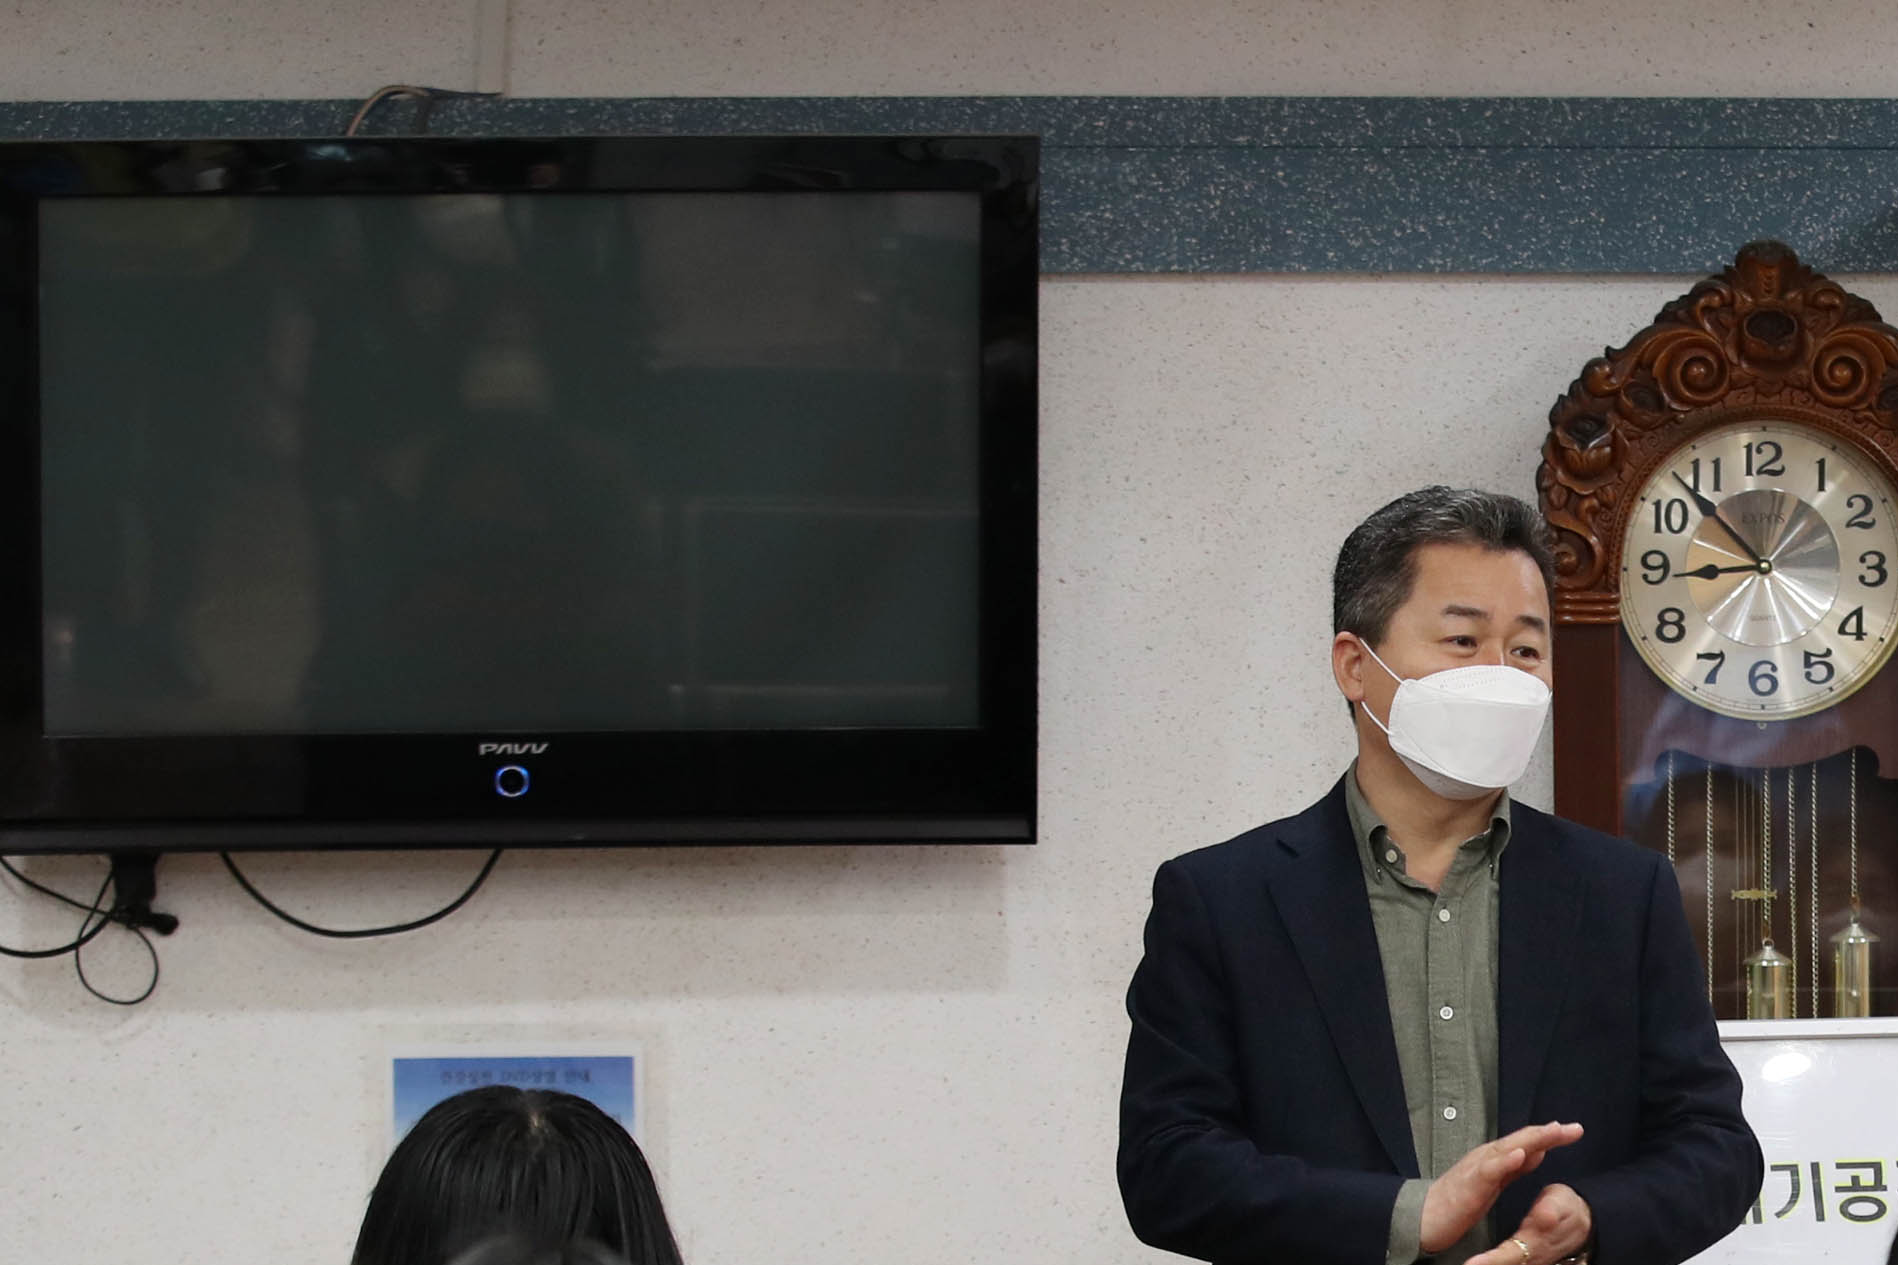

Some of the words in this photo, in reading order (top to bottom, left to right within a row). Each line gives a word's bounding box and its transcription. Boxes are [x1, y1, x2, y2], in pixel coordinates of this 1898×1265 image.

[1691, 457, 1722, 492] 11
[1743, 440, 1786, 477] 12
[1815, 457, 1827, 492] 1
[1652, 498, 1690, 534] 10
[1845, 494, 1876, 529] 2
[1640, 549, 1671, 586] 9
[1858, 551, 1889, 588] 3
[1655, 607, 1687, 644] 8
[1837, 606, 1868, 641] 4
[1696, 650, 1726, 685] 7
[1748, 660, 1779, 697] 6
[1803, 647, 1835, 685] 5
[479, 743, 549, 756] PAVV
